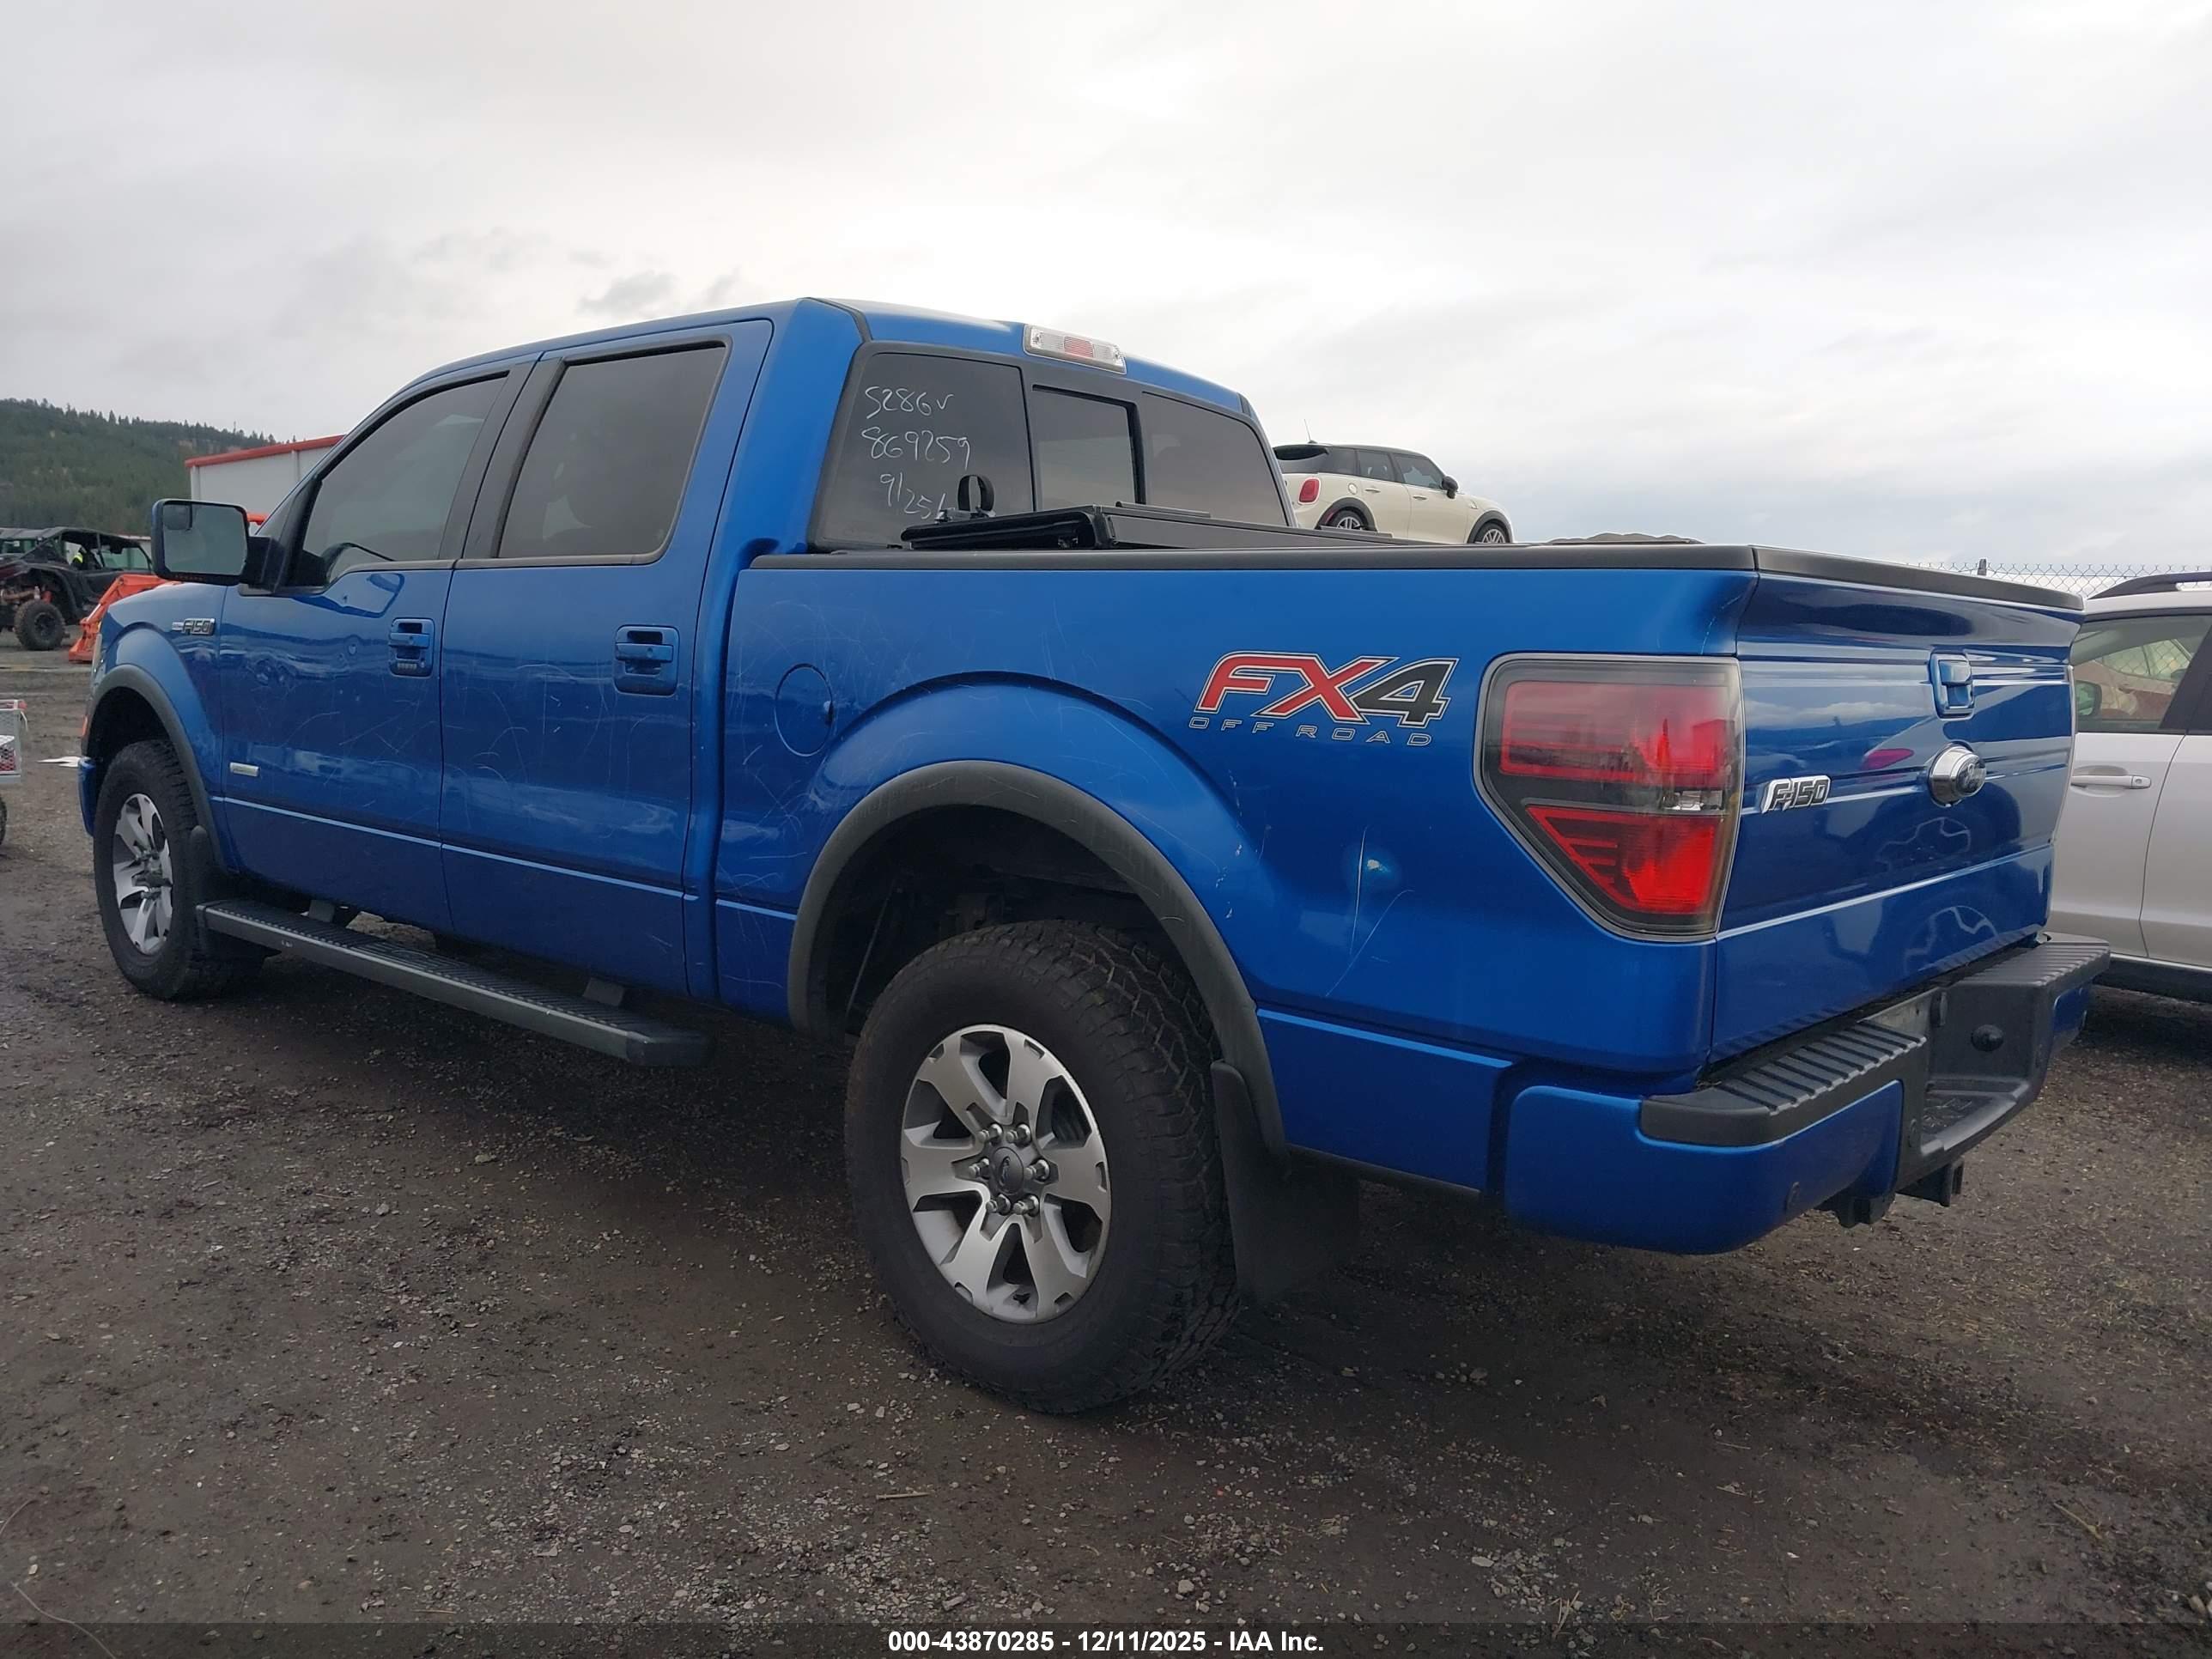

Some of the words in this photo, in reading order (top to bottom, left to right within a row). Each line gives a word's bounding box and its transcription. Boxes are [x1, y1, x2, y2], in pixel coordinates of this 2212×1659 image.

[1194, 651, 1459, 728] FX4
[1188, 716, 1274, 733] OFF
[1295, 725, 1432, 746] ROAD
